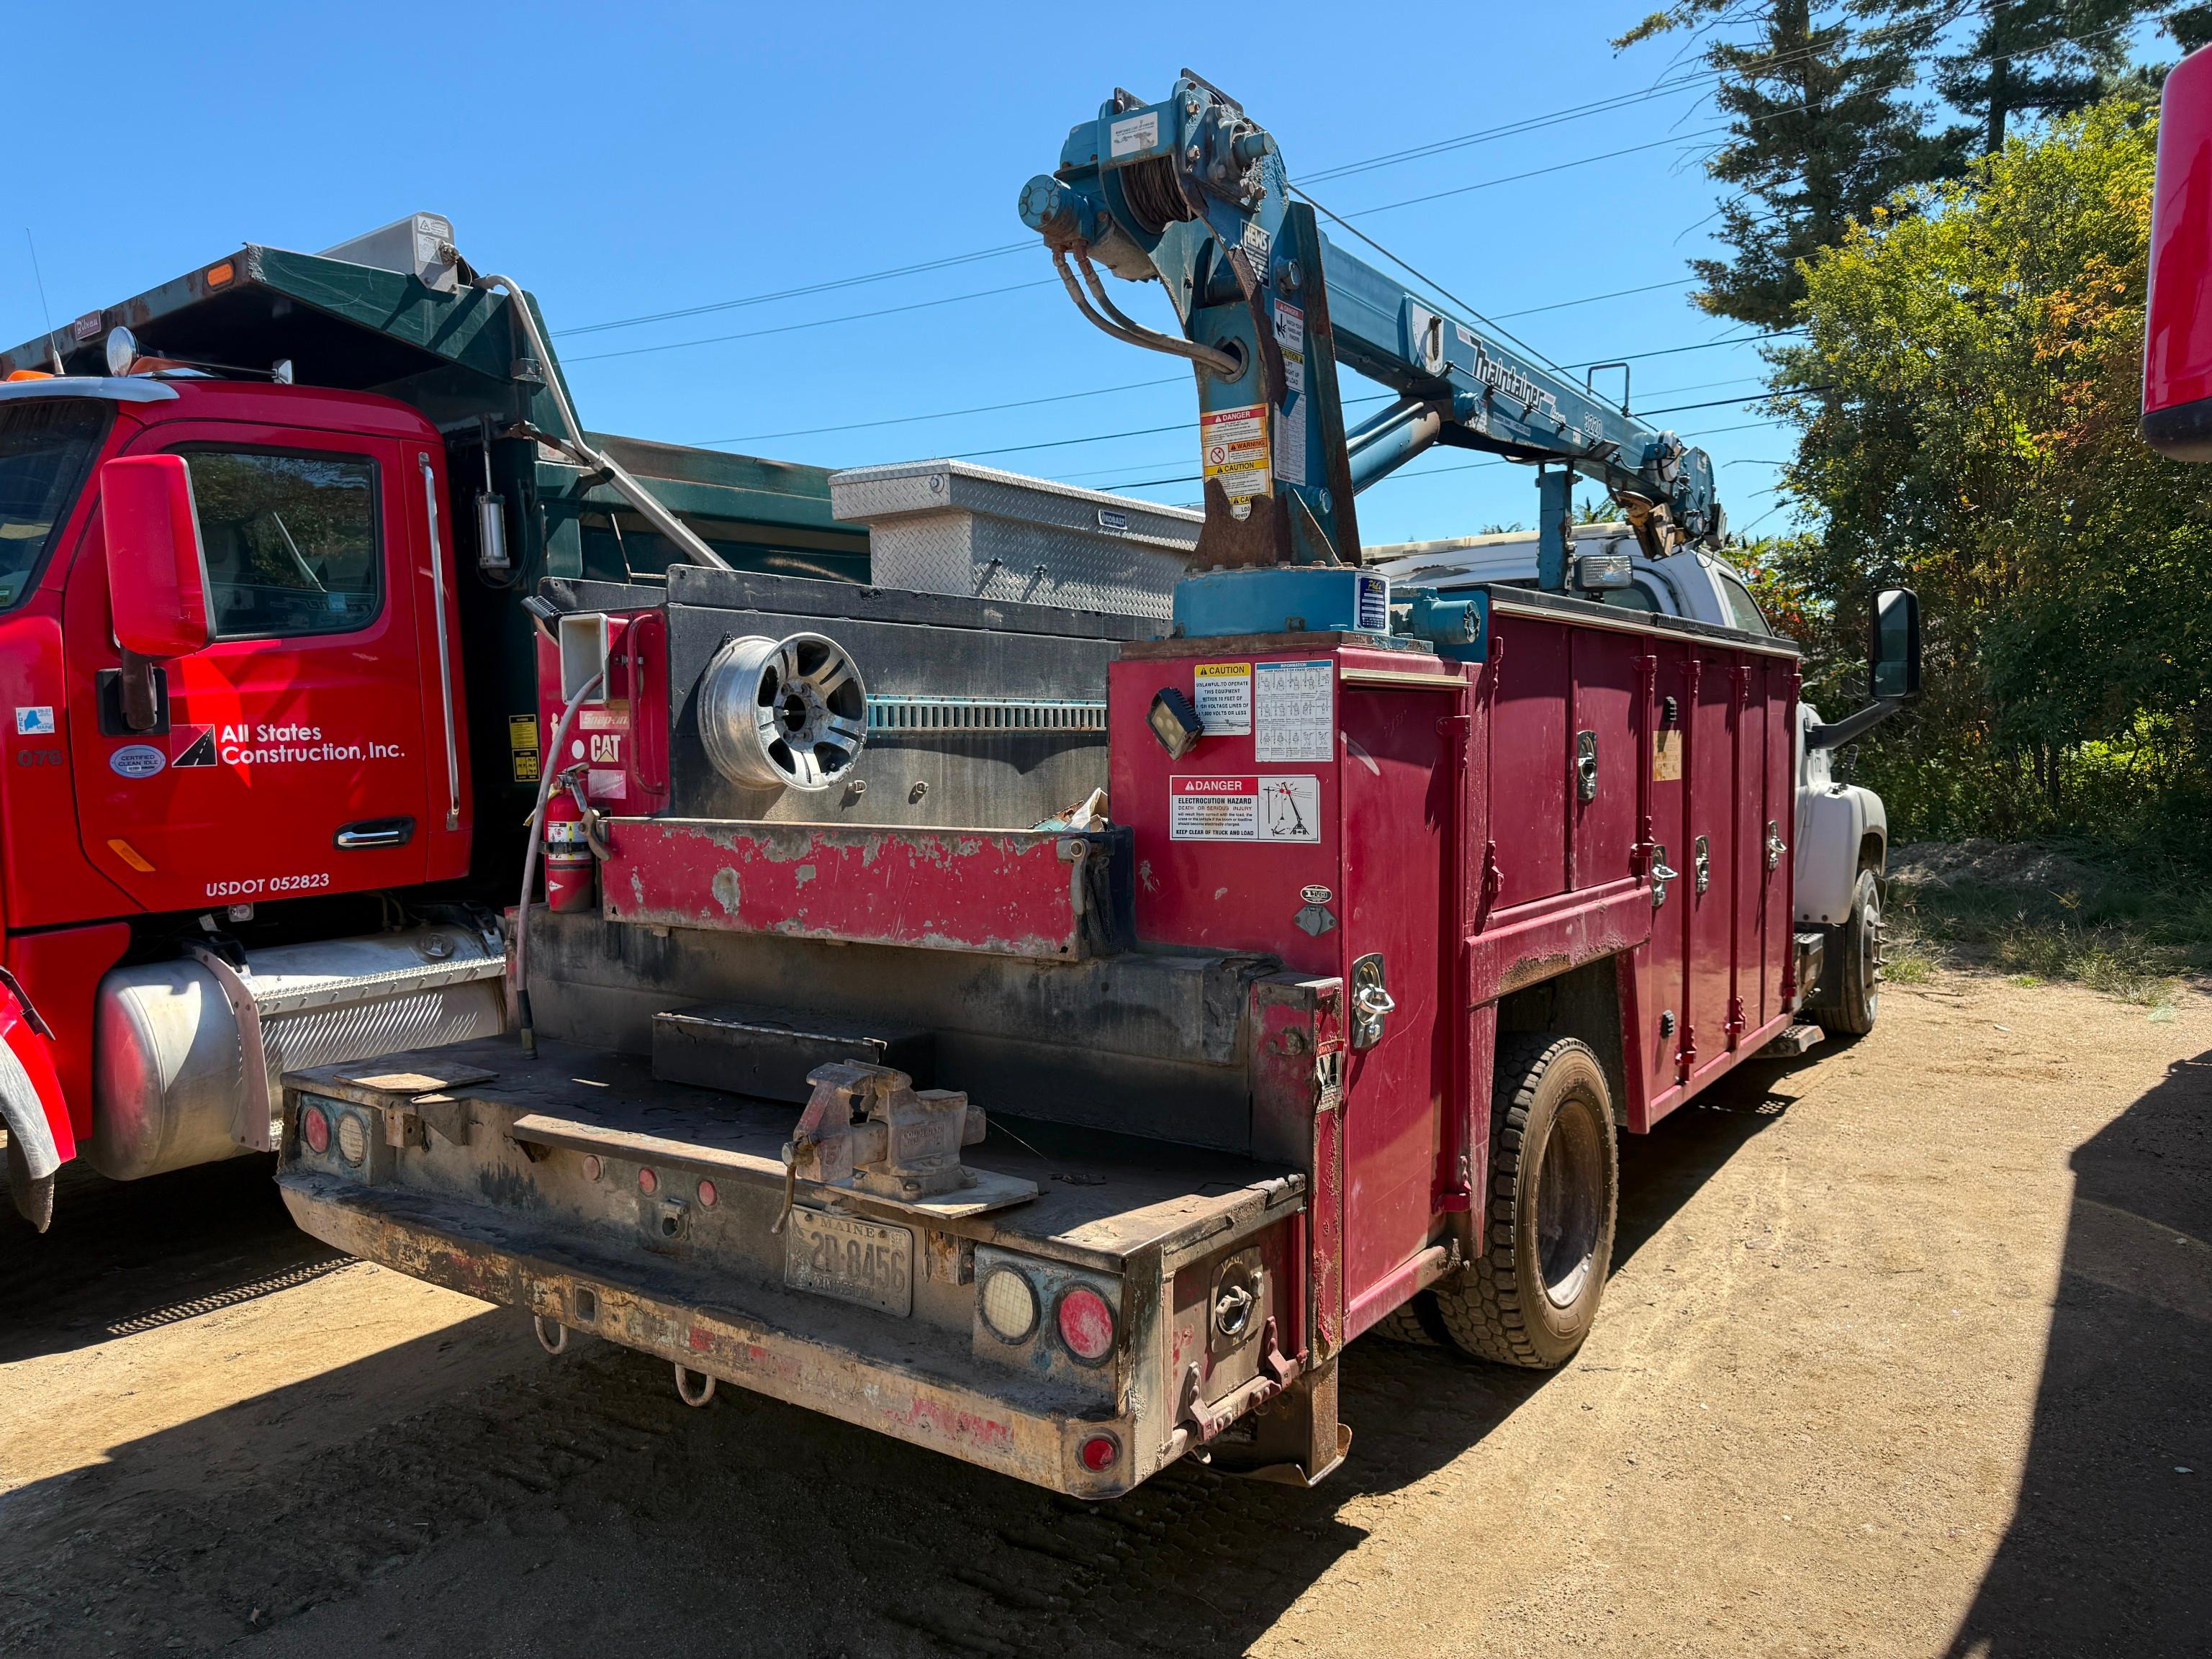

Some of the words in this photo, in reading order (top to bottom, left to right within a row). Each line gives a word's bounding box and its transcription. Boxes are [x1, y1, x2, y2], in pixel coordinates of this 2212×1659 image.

[1222, 411, 1250, 421] DANGER
[1584, 411, 1602, 439] 3220
[1237, 440, 1265, 449] WARNING
[1224, 461, 1255, 472] CAUTION
[1105, 514, 1125, 525] KOBALT
[1209, 666, 1245, 674] CAUTION
[220, 724, 249, 743] All
[256, 723, 322, 742] States
[221, 743, 366, 765] Construction,
[369, 741, 405, 759] Inc.
[590, 734, 621, 762] CAT
[17, 749, 63, 767] 076
[1196, 781, 1242, 791] DANGER
[207, 879, 266, 897] USDOT
[269, 873, 330, 892] 052823
[821, 1219, 875, 1239] MAINE
